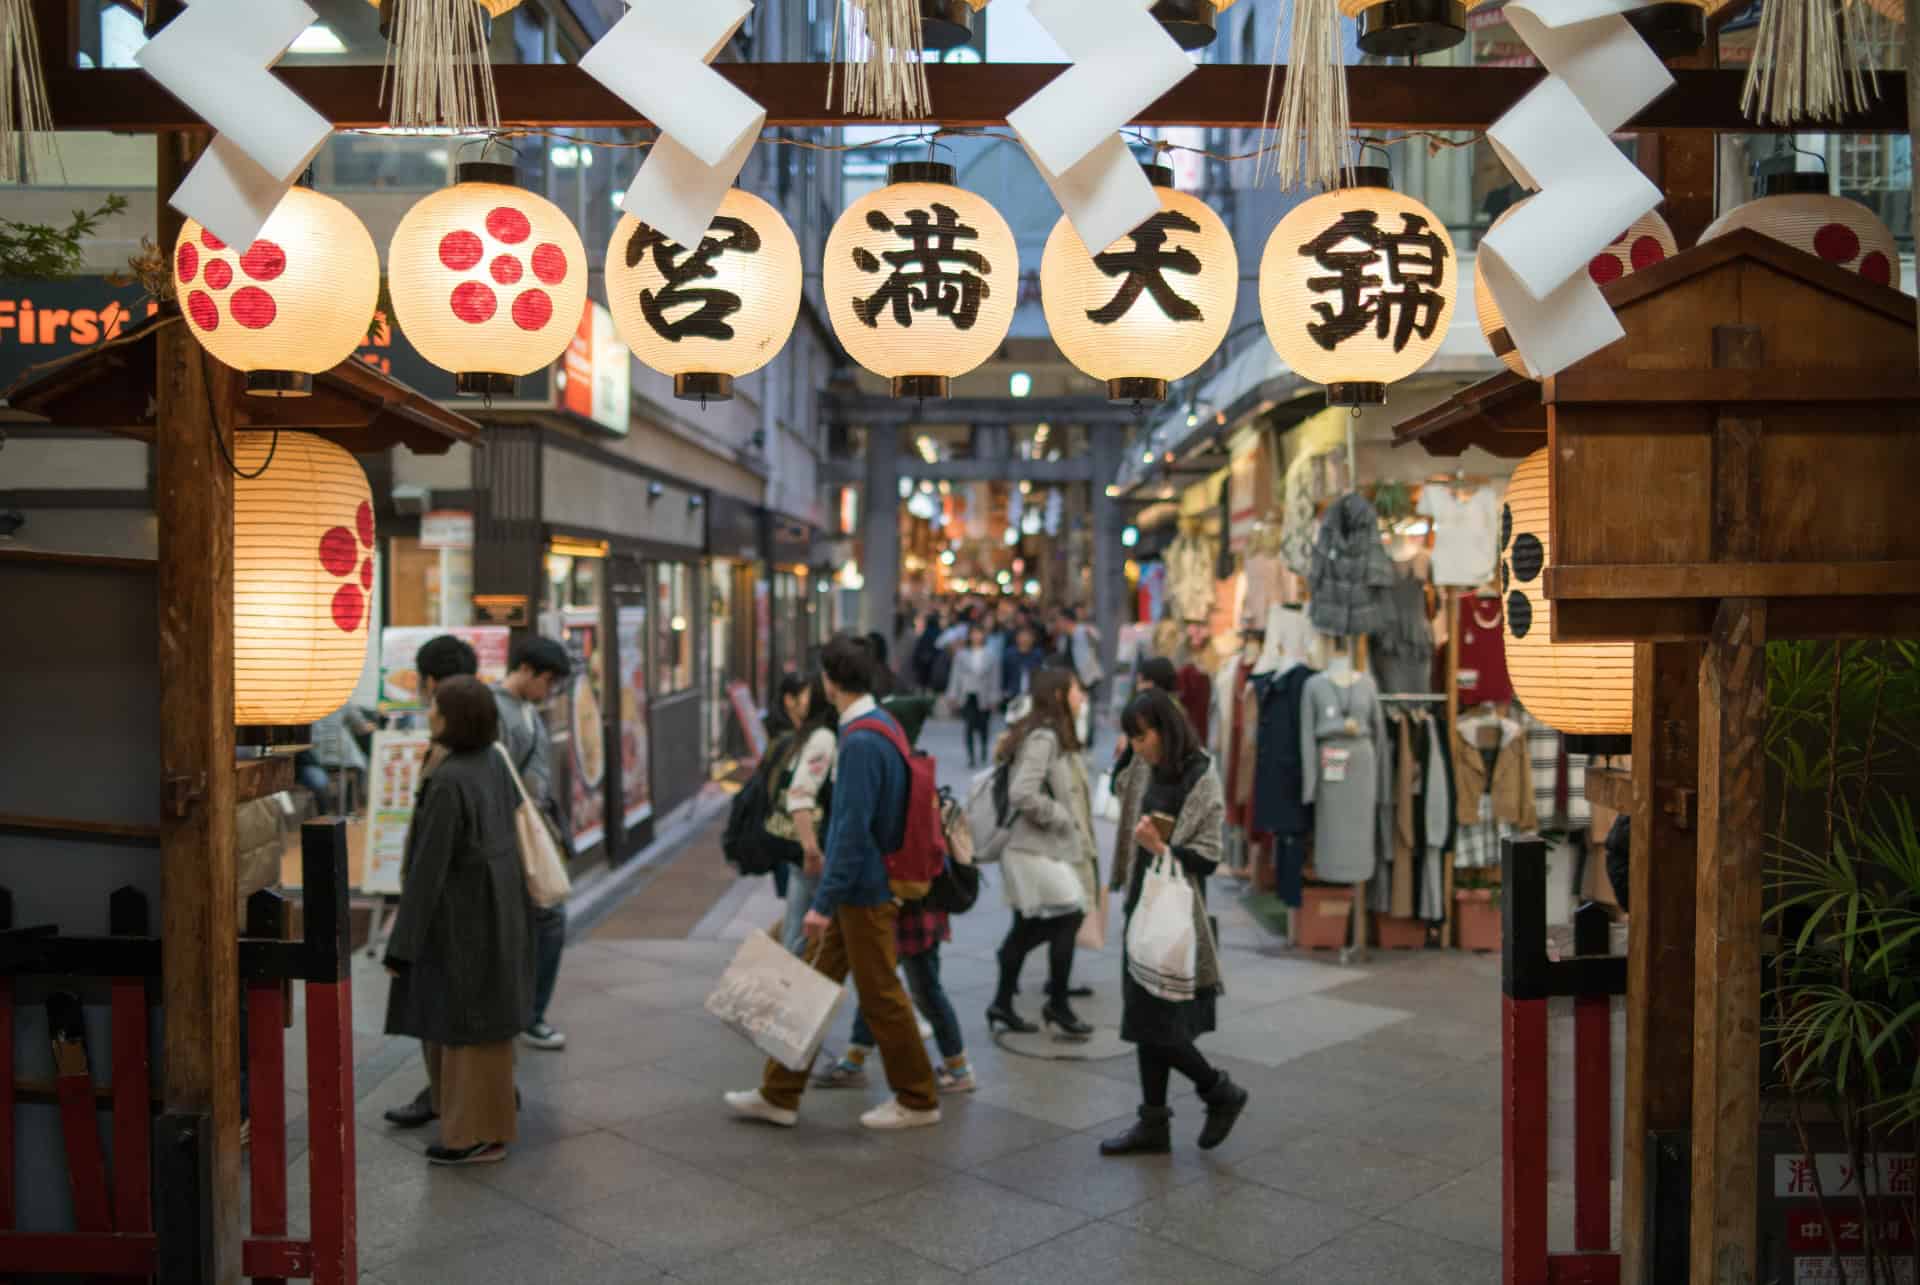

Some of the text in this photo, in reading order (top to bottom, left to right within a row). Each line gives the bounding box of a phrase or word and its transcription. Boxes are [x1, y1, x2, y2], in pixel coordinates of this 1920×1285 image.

[0, 299, 131, 345] First
[852, 203, 992, 330] 満
[1086, 212, 1205, 324] 天
[1297, 210, 1449, 353] 錦
